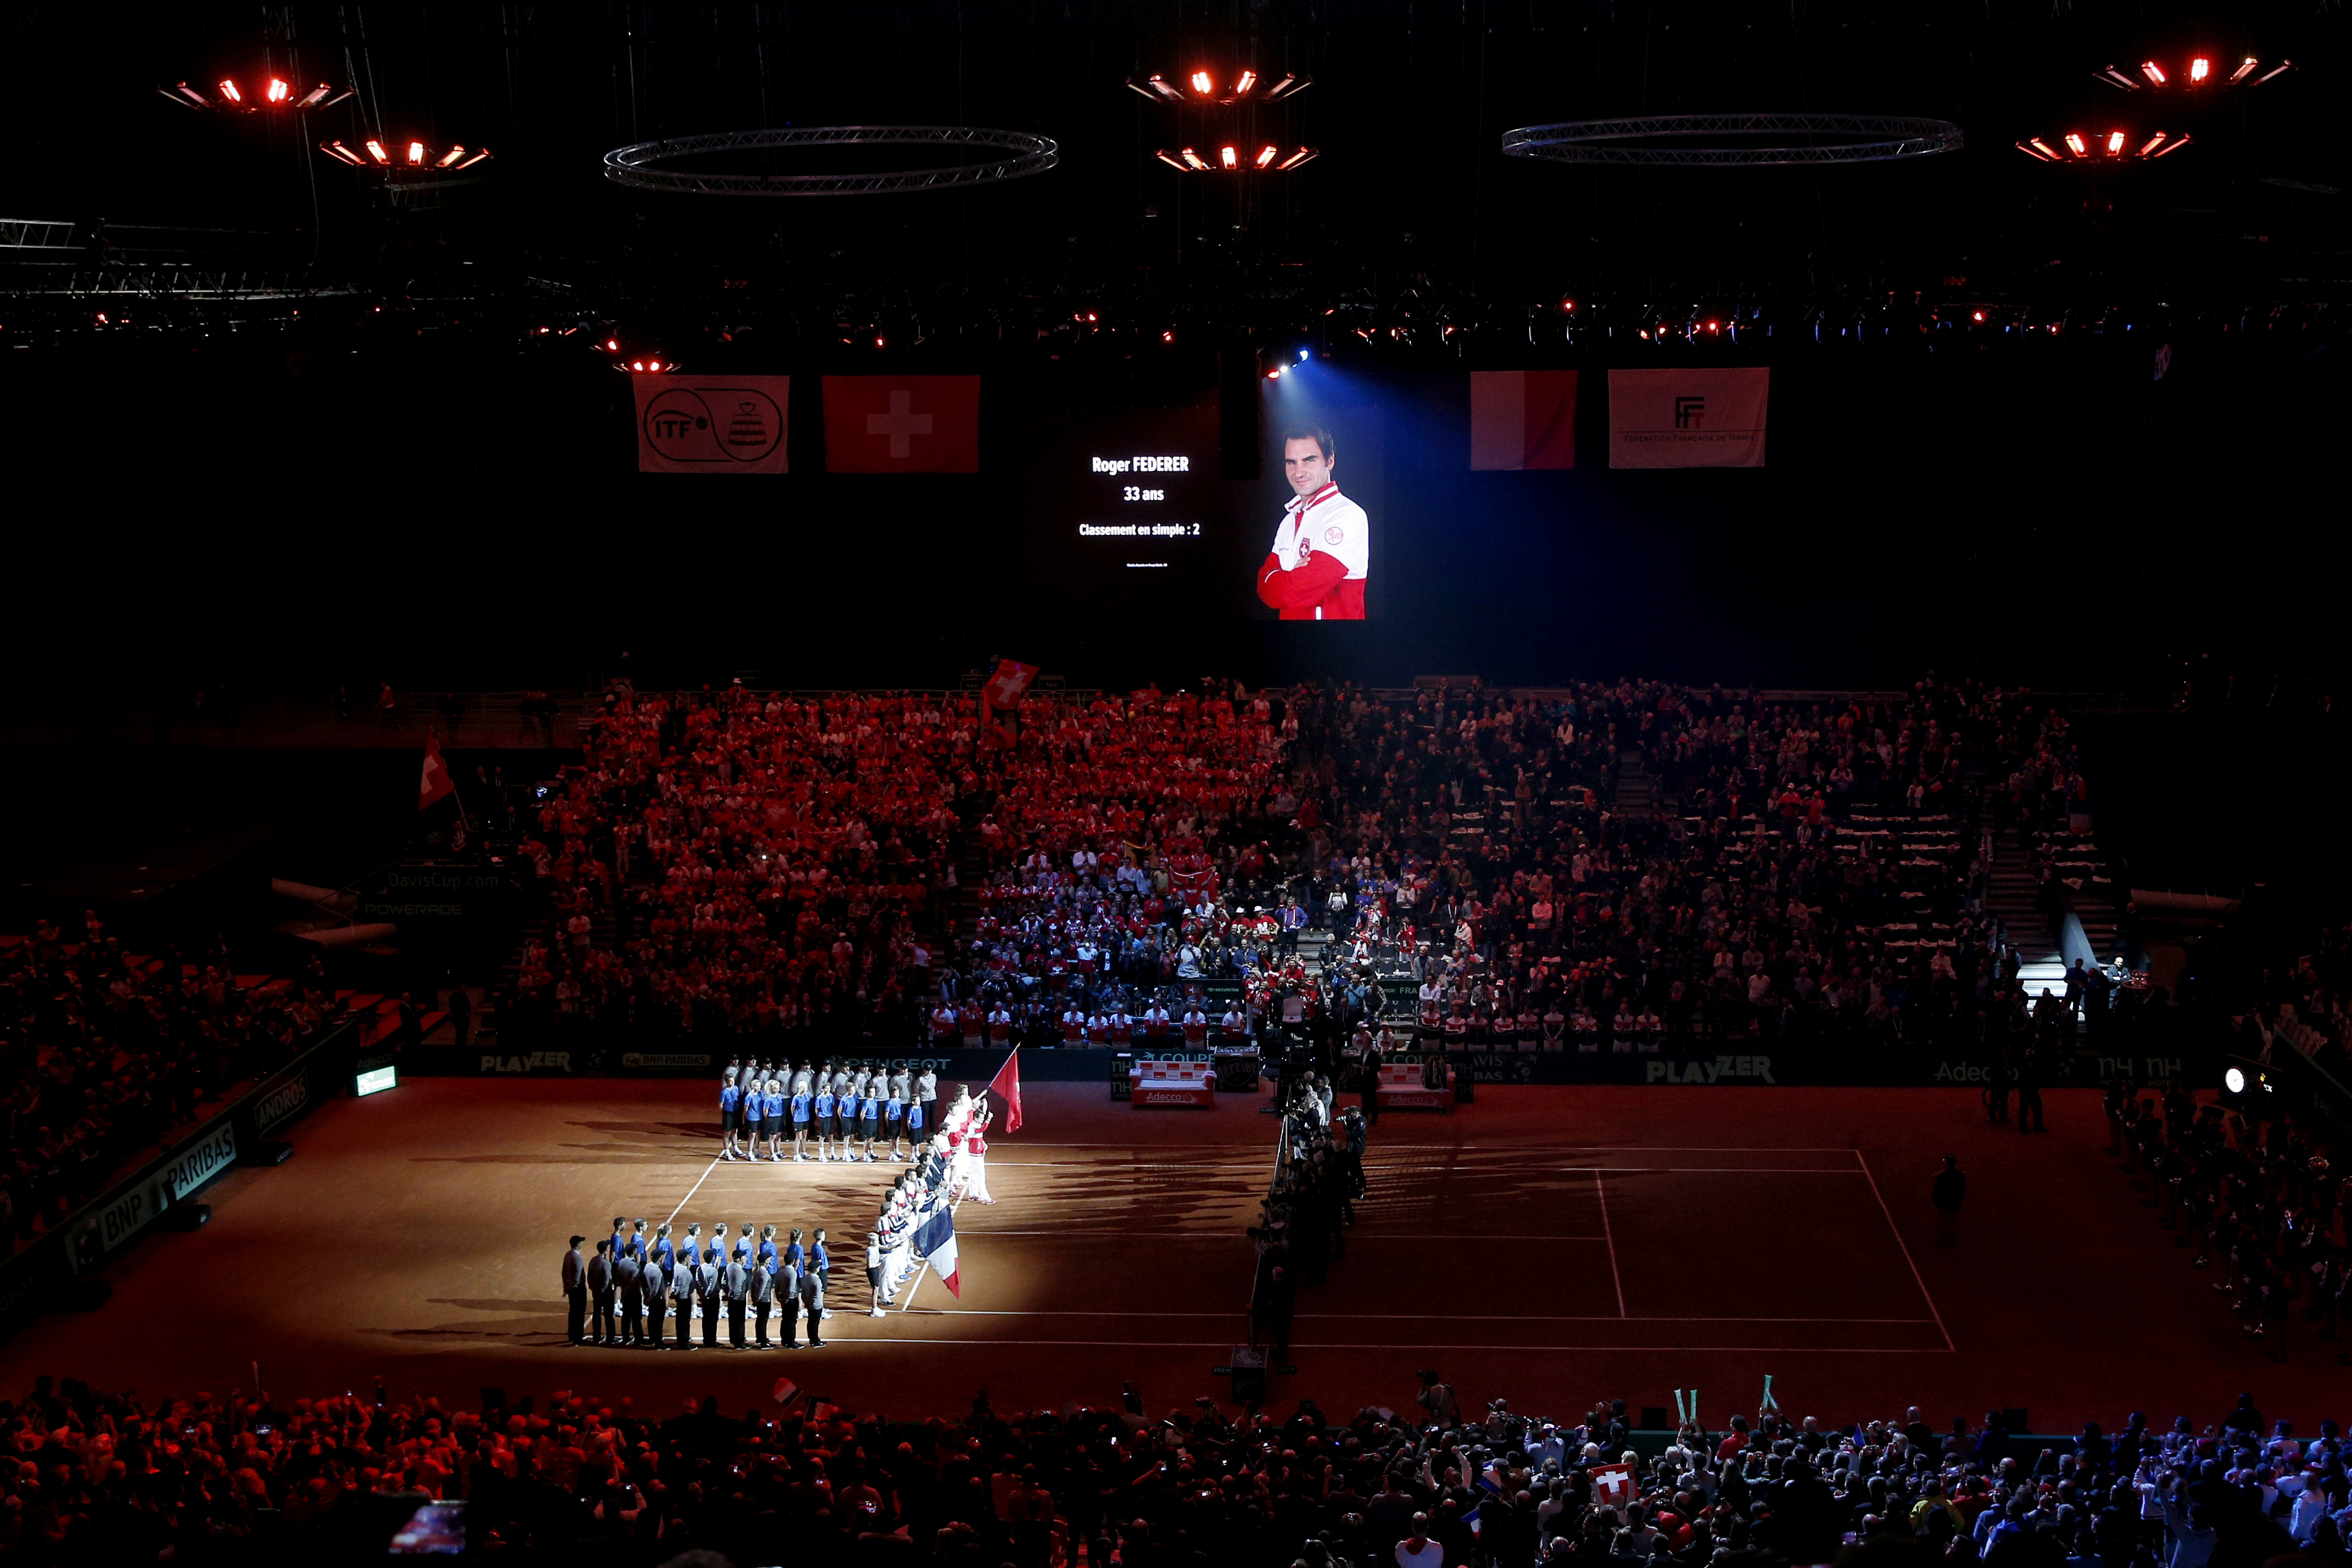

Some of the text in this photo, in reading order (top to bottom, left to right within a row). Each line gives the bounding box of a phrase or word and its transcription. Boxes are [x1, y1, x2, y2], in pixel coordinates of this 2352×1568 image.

[1676, 397, 1704, 428] FFT
[655, 420, 691, 439] ITF
[1092, 456, 1190, 476] Roger FEDERER
[1123, 486, 1165, 501] 33 ans
[1079, 523, 1137, 536] Classement
[1137, 526, 1150, 535] en
[1152, 523, 1186, 538] simple
[1192, 523, 1200, 535] 2
[388, 872, 499, 891] DavisCup.com
[365, 903, 464, 915] POWERADE
[355, 1053, 394, 1070] Adecco
[480, 1051, 572, 1072] PLAYZER
[643, 1056, 706, 1064] BNP PARIBAS
[1160, 1054, 1215, 1064] COUPE
[1646, 1055, 1776, 1083] PLAYZER
[1933, 1060, 2020, 1082] Adec
[258, 1076, 307, 1130] ANDROS
[1145, 1092, 1182, 1101] Adecco
[1388, 1094, 1424, 1104] Adecco
[105, 1128, 232, 1241] BNP PARIBAS
